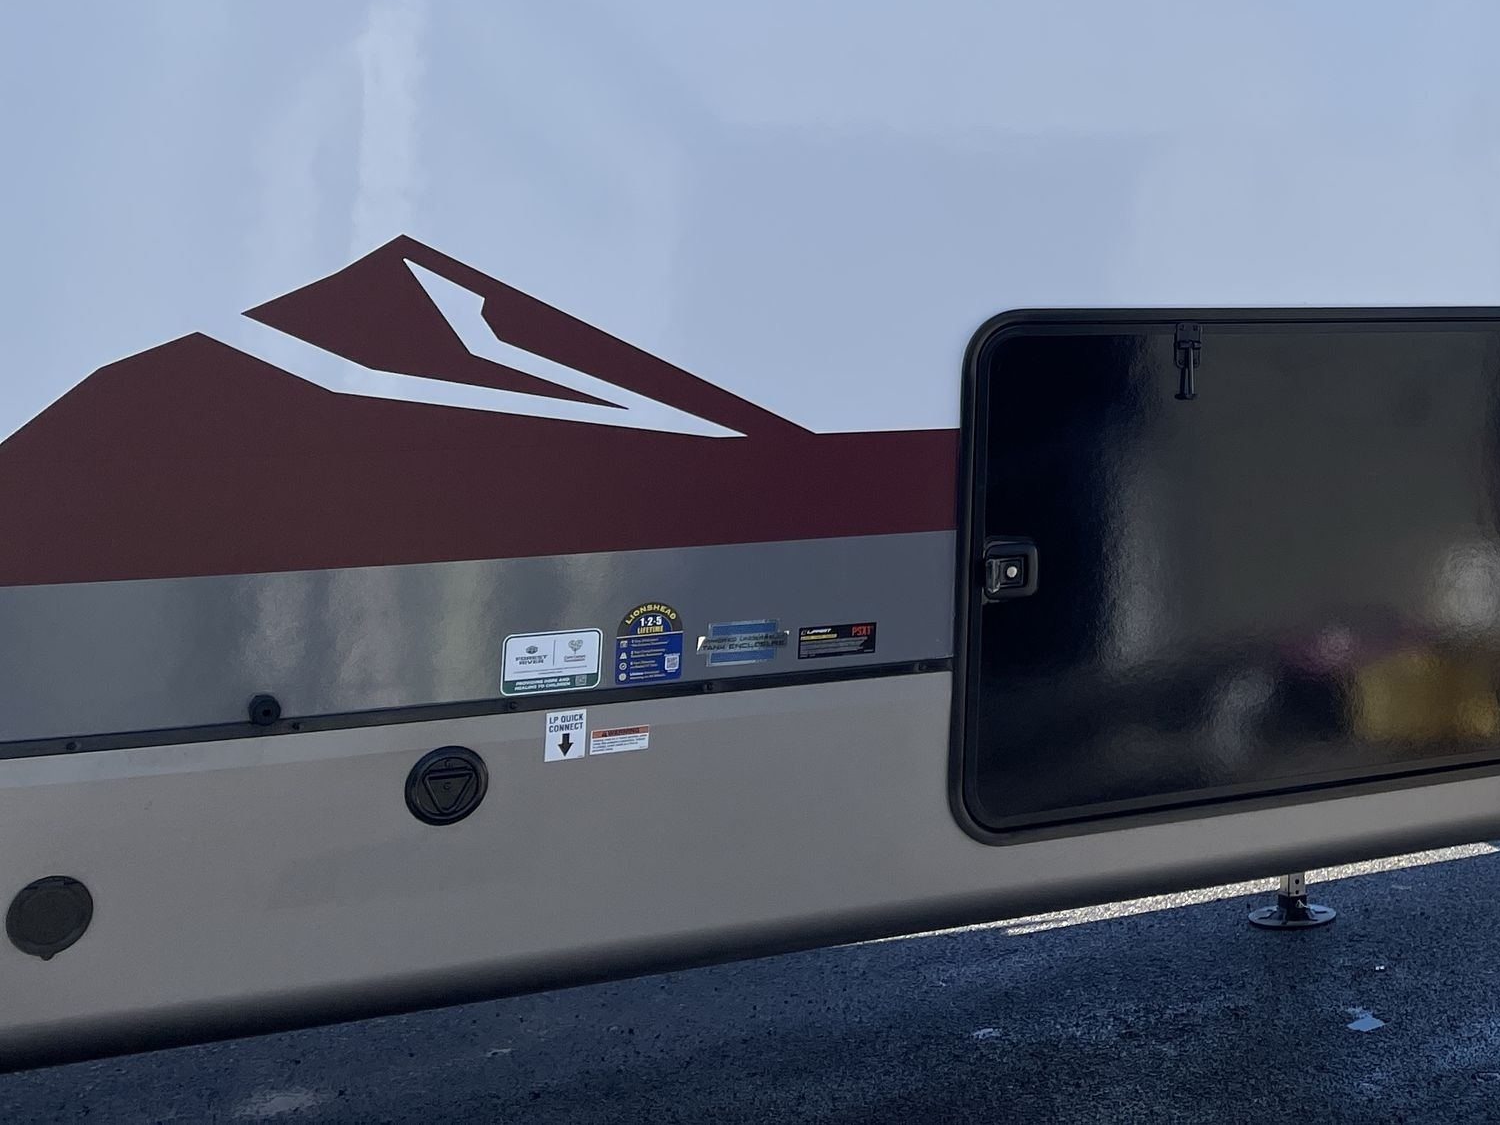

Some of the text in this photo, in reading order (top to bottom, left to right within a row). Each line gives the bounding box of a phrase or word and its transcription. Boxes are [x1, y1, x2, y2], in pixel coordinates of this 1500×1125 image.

[625, 603, 677, 625] LIONSHEAD
[637, 625, 664, 634] LIFETIME
[549, 713, 584, 724] LP QUICK
[548, 722, 584, 733] CONNECT
